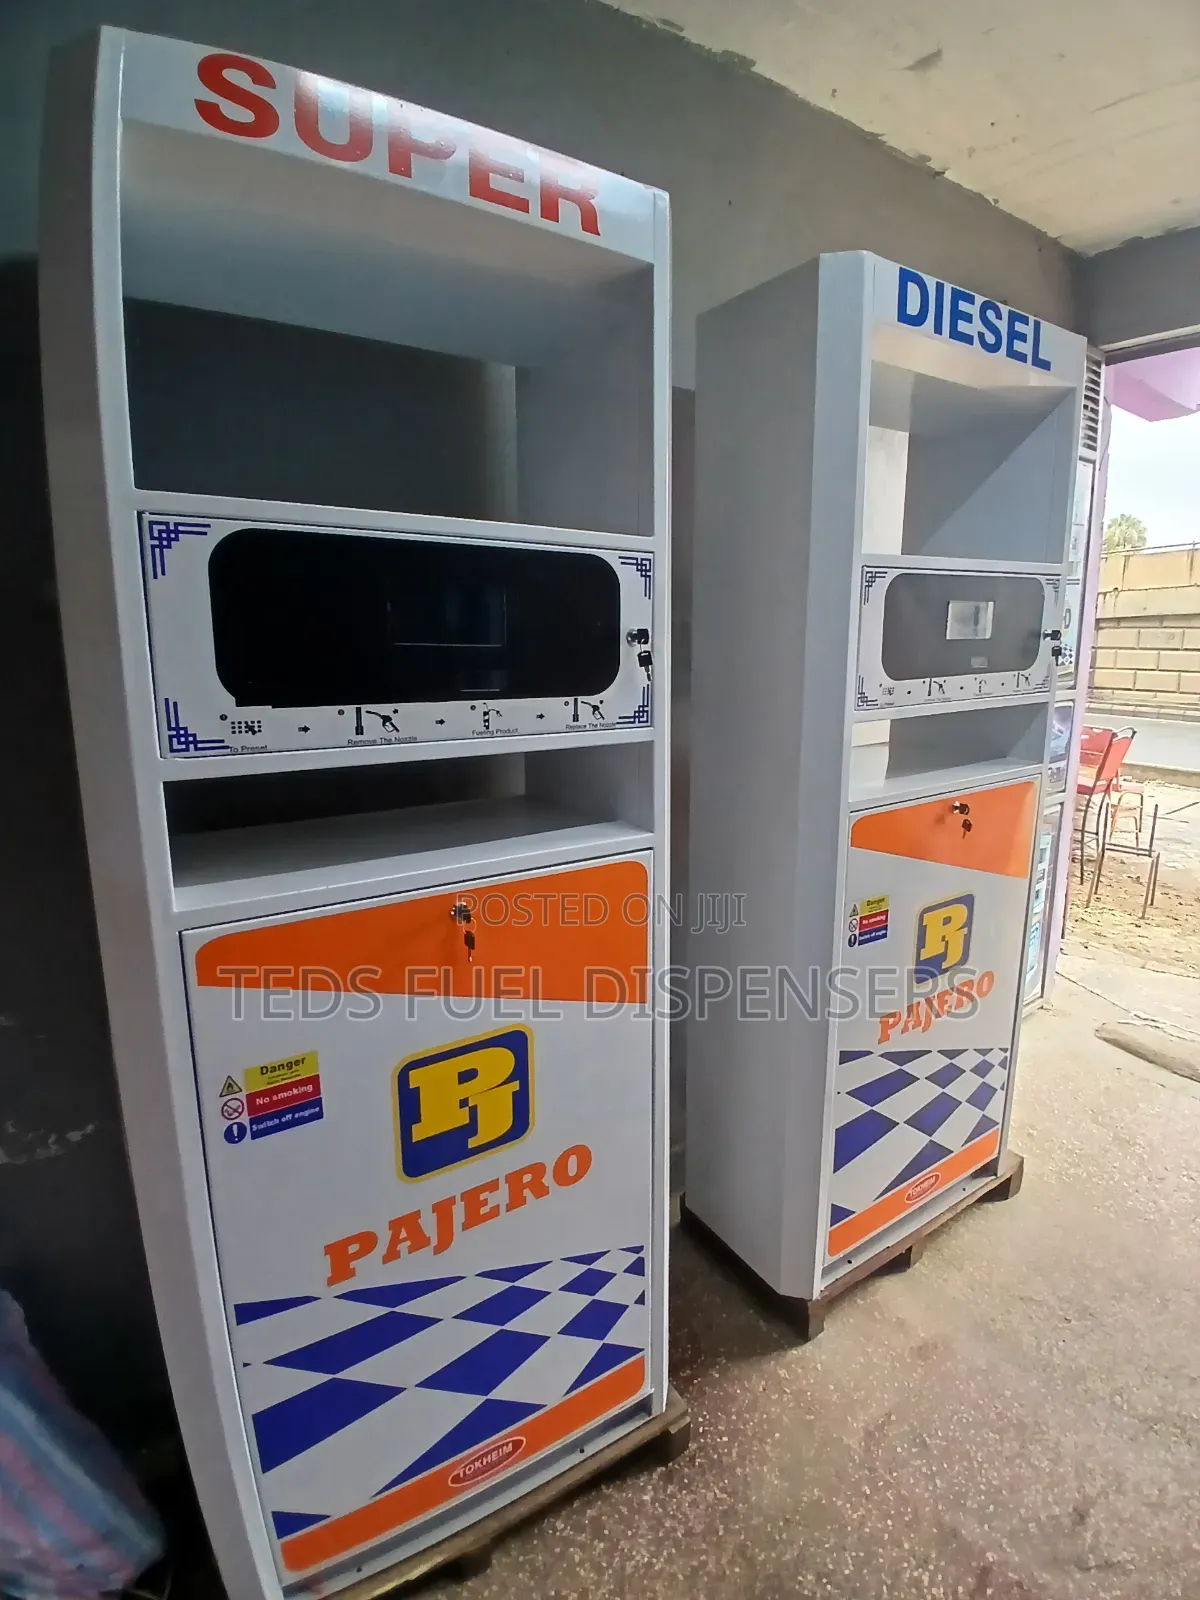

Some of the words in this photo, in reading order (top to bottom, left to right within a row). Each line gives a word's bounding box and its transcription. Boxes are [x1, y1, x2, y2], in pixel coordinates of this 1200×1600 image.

[193, 53, 601, 236] SUPER
[897, 266, 1052, 372] DIESEL
[347, 737, 377, 746] Remove
[379, 736, 393, 744] The
[394, 735, 418, 743] Nozzle
[877, 970, 995, 1045] PAJERO
[260, 1056, 307, 1076] Danger
[255, 1097, 270, 1106] No
[272, 1084, 313, 1101] smoking
[251, 1118, 280, 1132] Switch
[281, 1113, 293, 1122] off
[294, 1106, 320, 1118] engine
[323, 1144, 593, 1288] PAJERO
[459, 1442, 513, 1478] TOKHEIM
